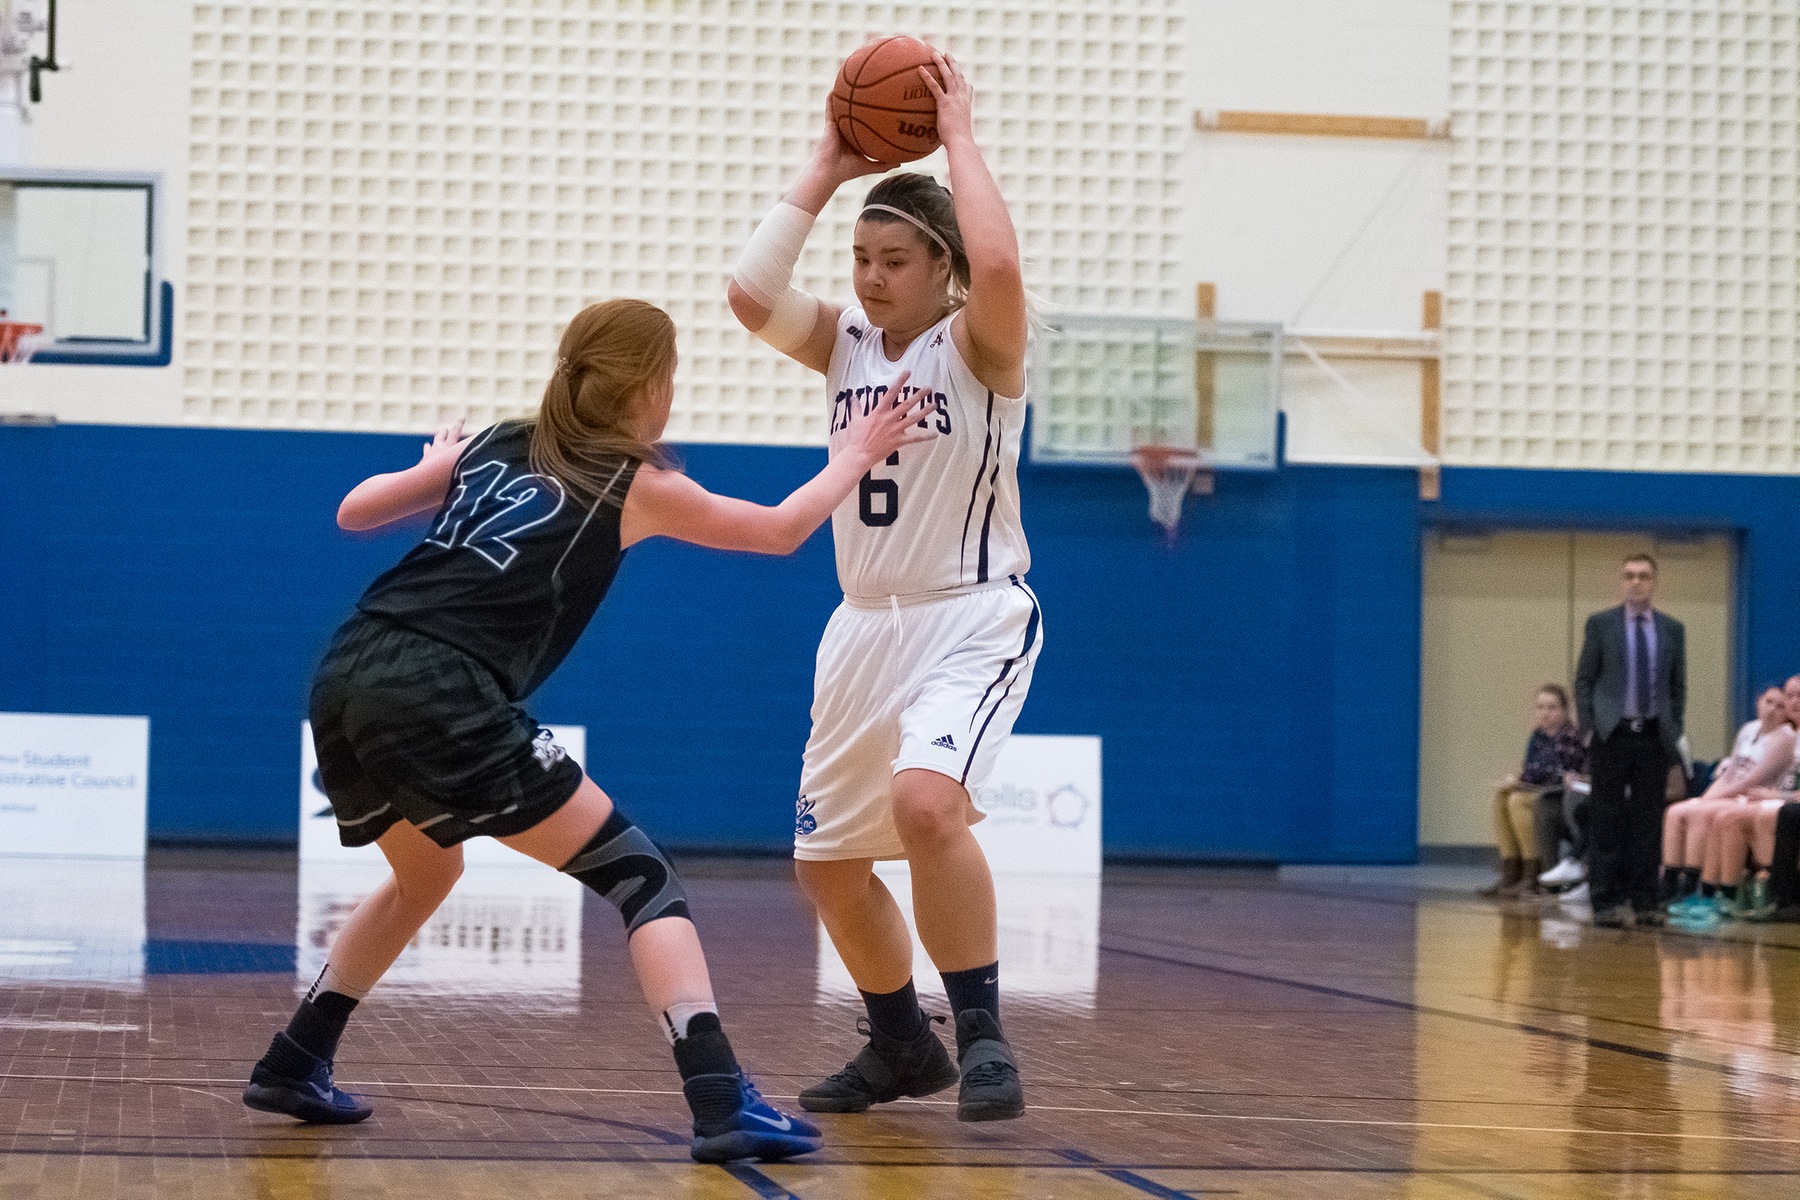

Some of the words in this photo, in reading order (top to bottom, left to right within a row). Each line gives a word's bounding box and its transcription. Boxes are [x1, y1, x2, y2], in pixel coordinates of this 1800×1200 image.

[859, 449, 899, 527] 6
[425, 460, 565, 570] 12
[931, 741, 957, 751] adidas
[71, 772, 137, 789] Council
